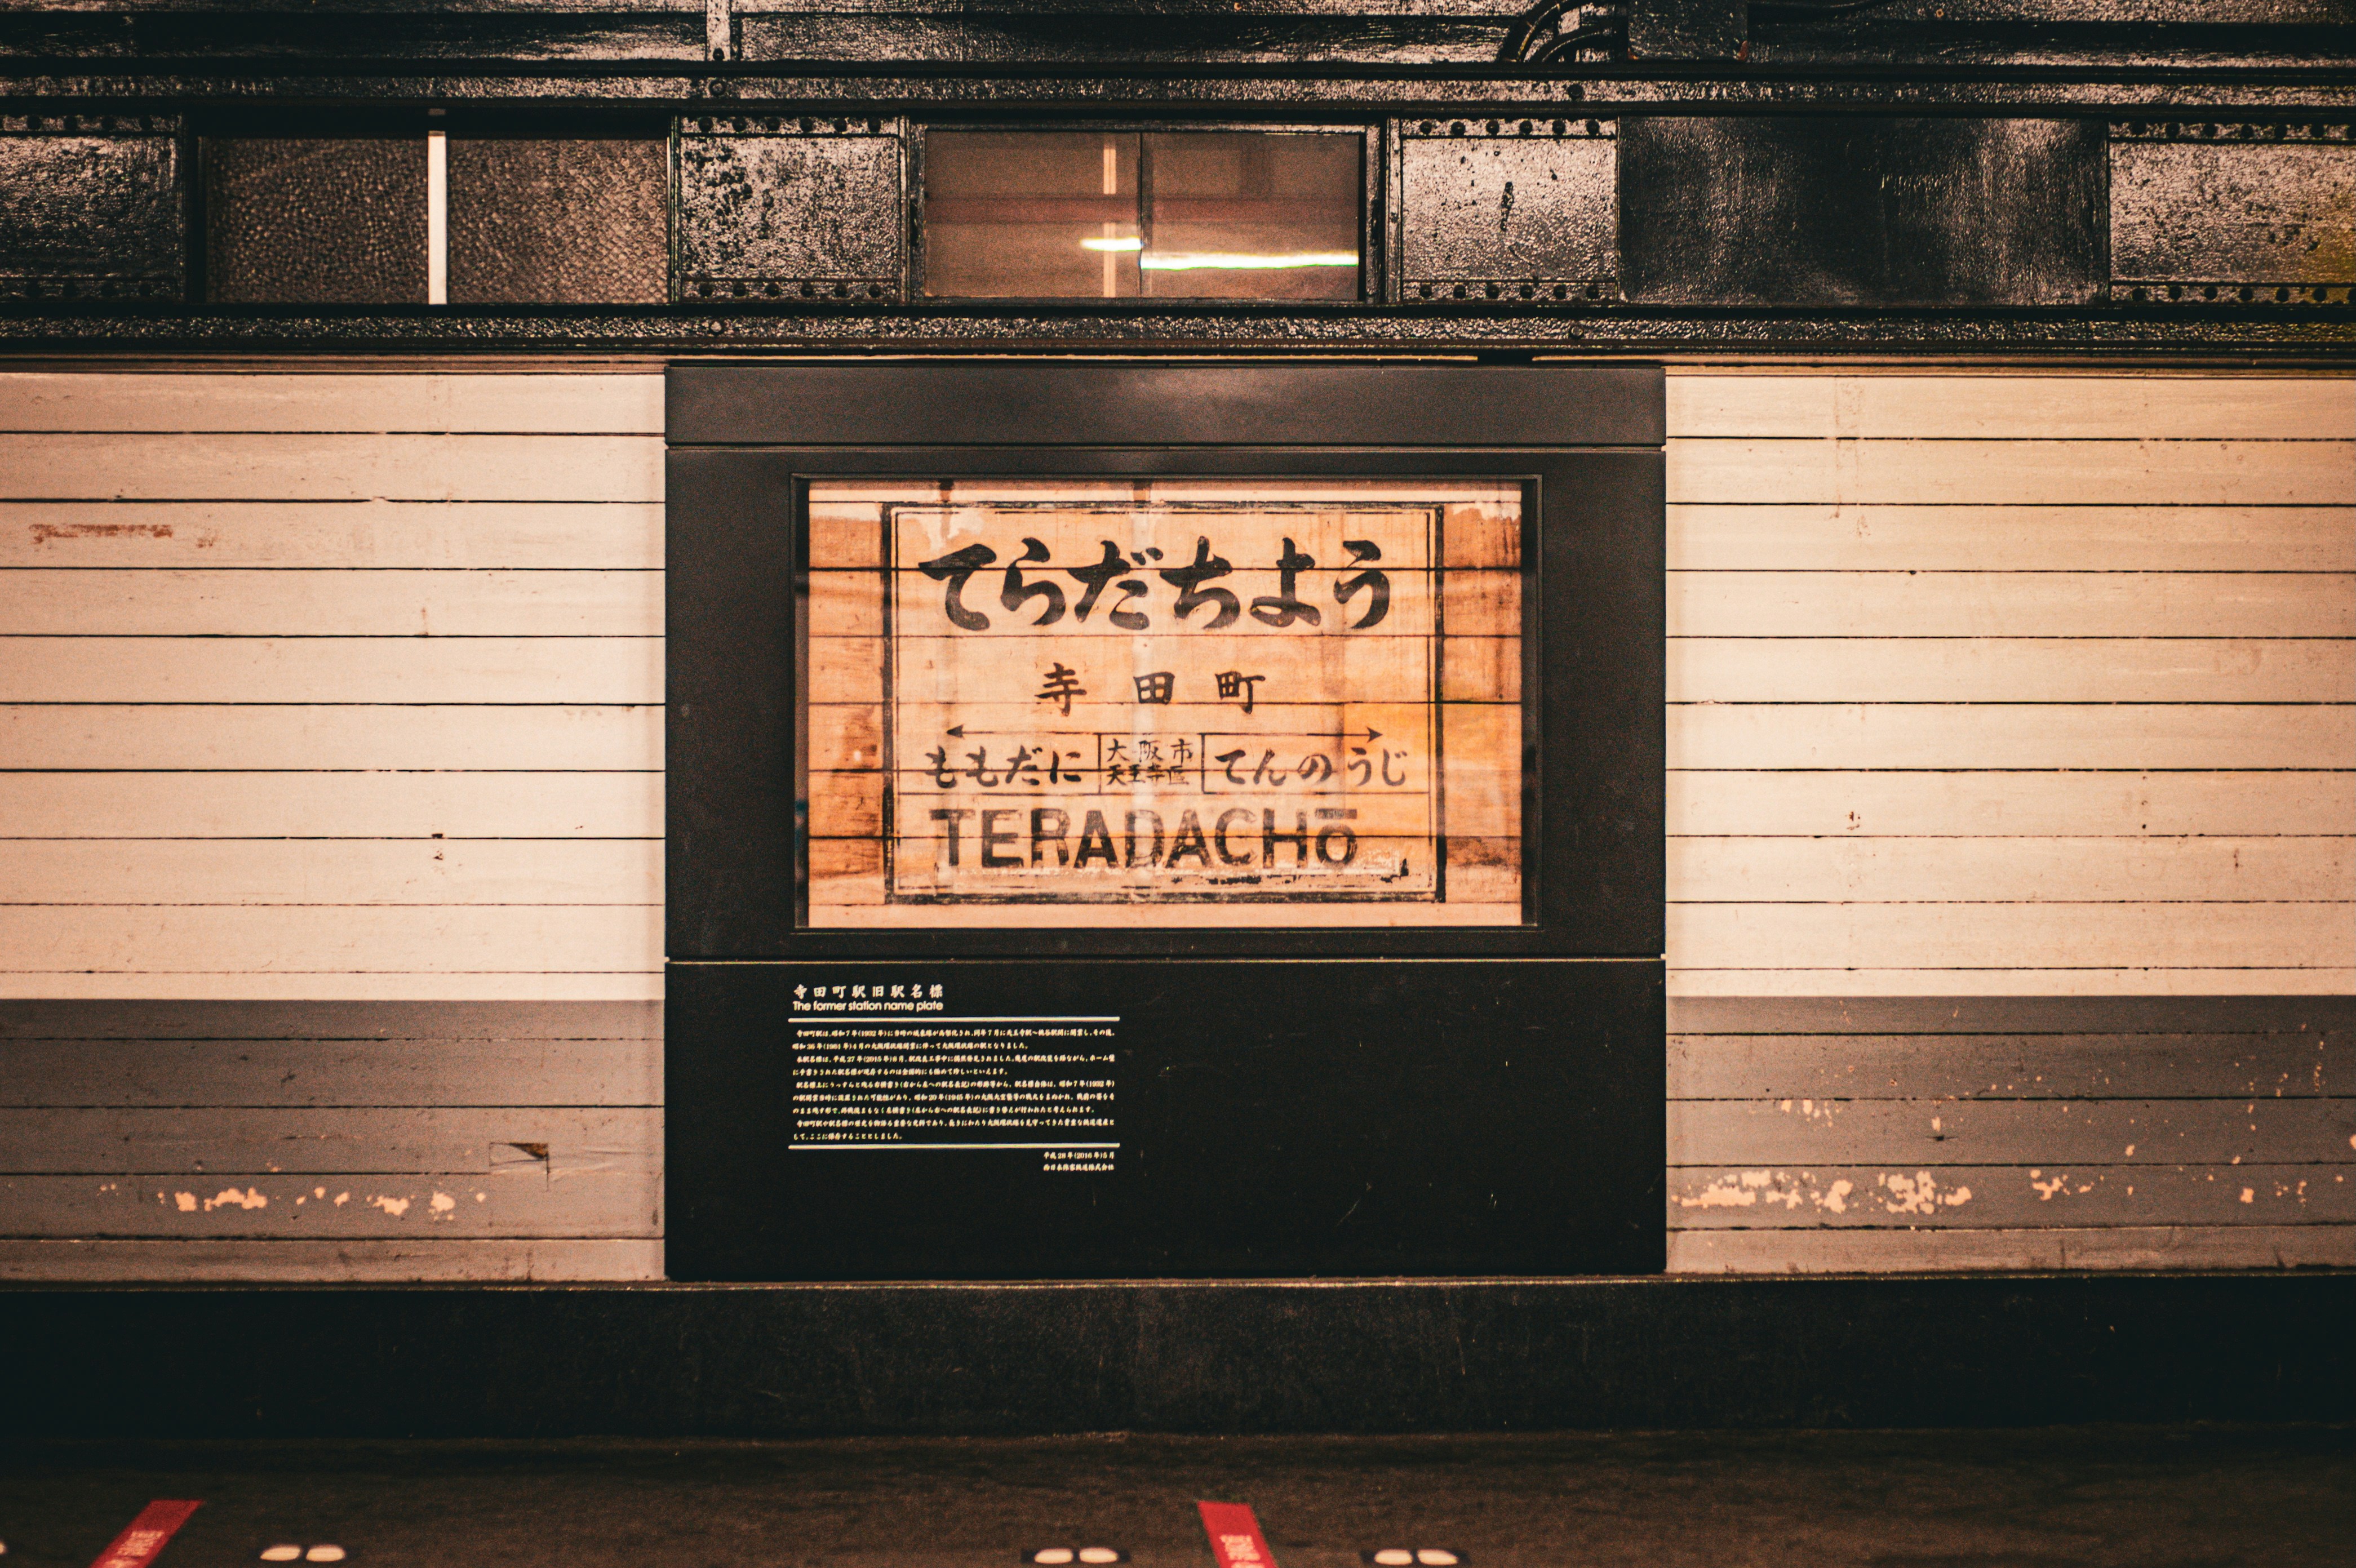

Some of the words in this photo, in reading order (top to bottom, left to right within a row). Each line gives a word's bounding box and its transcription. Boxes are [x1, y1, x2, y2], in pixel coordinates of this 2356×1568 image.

[917, 535, 1392, 632] てらだちよう
[1035, 663, 1266, 716] 寺田町
[924, 746, 1082, 789] ももだに
[1106, 738, 1193, 765] 大阪市
[1214, 748, 1407, 788] てんのうじ
[792, 1000, 811, 1011] The
[813, 1000, 847, 1011] former
[848, 1000, 882, 1011] station
[884, 1000, 915, 1011] name
[916, 1000, 943, 1012] plate
[793, 984, 943, 1000] 寺田町駅旧駅名標
